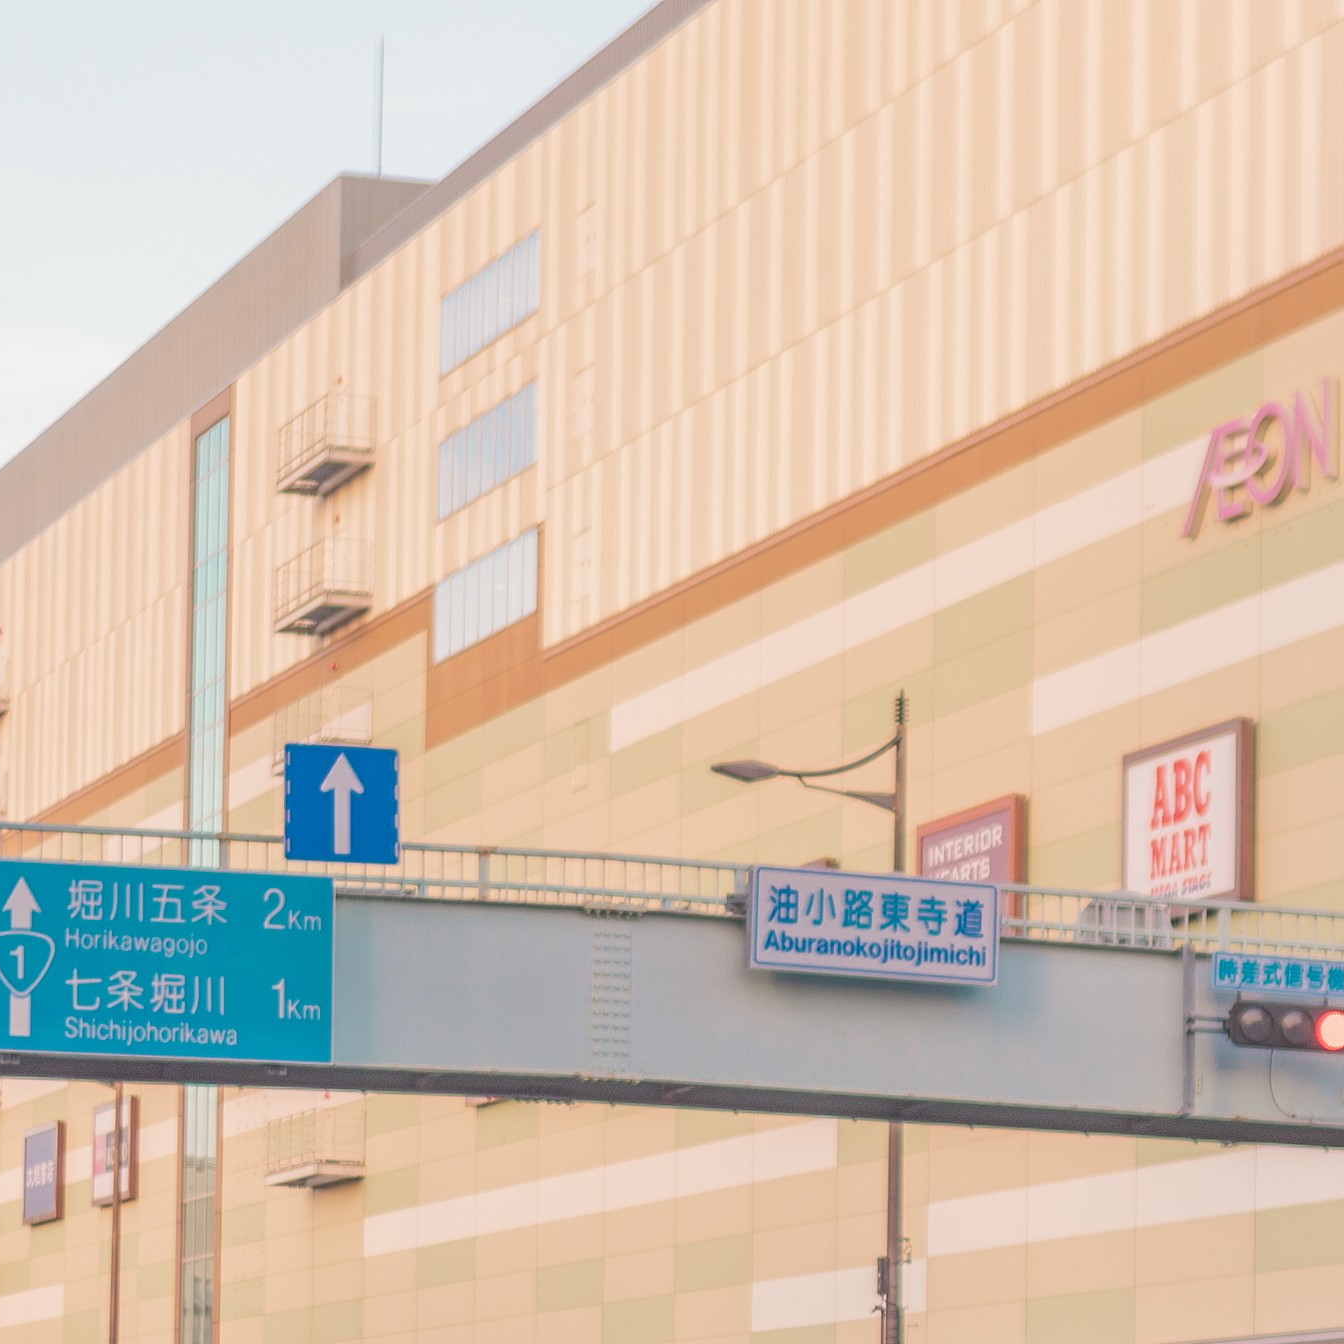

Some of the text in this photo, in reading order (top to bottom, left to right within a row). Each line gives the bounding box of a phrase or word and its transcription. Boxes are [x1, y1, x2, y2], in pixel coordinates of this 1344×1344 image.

[1150, 749, 1212, 831] ABC
[928, 824, 1003, 869] INTERIOR
[928, 856, 991, 882] EARTS
[1150, 824, 1212, 881] MART
[67, 878, 228, 926] 堀川五条
[767, 884, 984, 939] 油小路東寺道
[9, 945, 24, 980] 1
[64, 927, 208, 959] Horikawagojo
[763, 930, 987, 968] Aburanokojitojimichi
[64, 968, 226, 1016] 七条堀川
[64, 1016, 238, 1047] Shichijohorikawa
